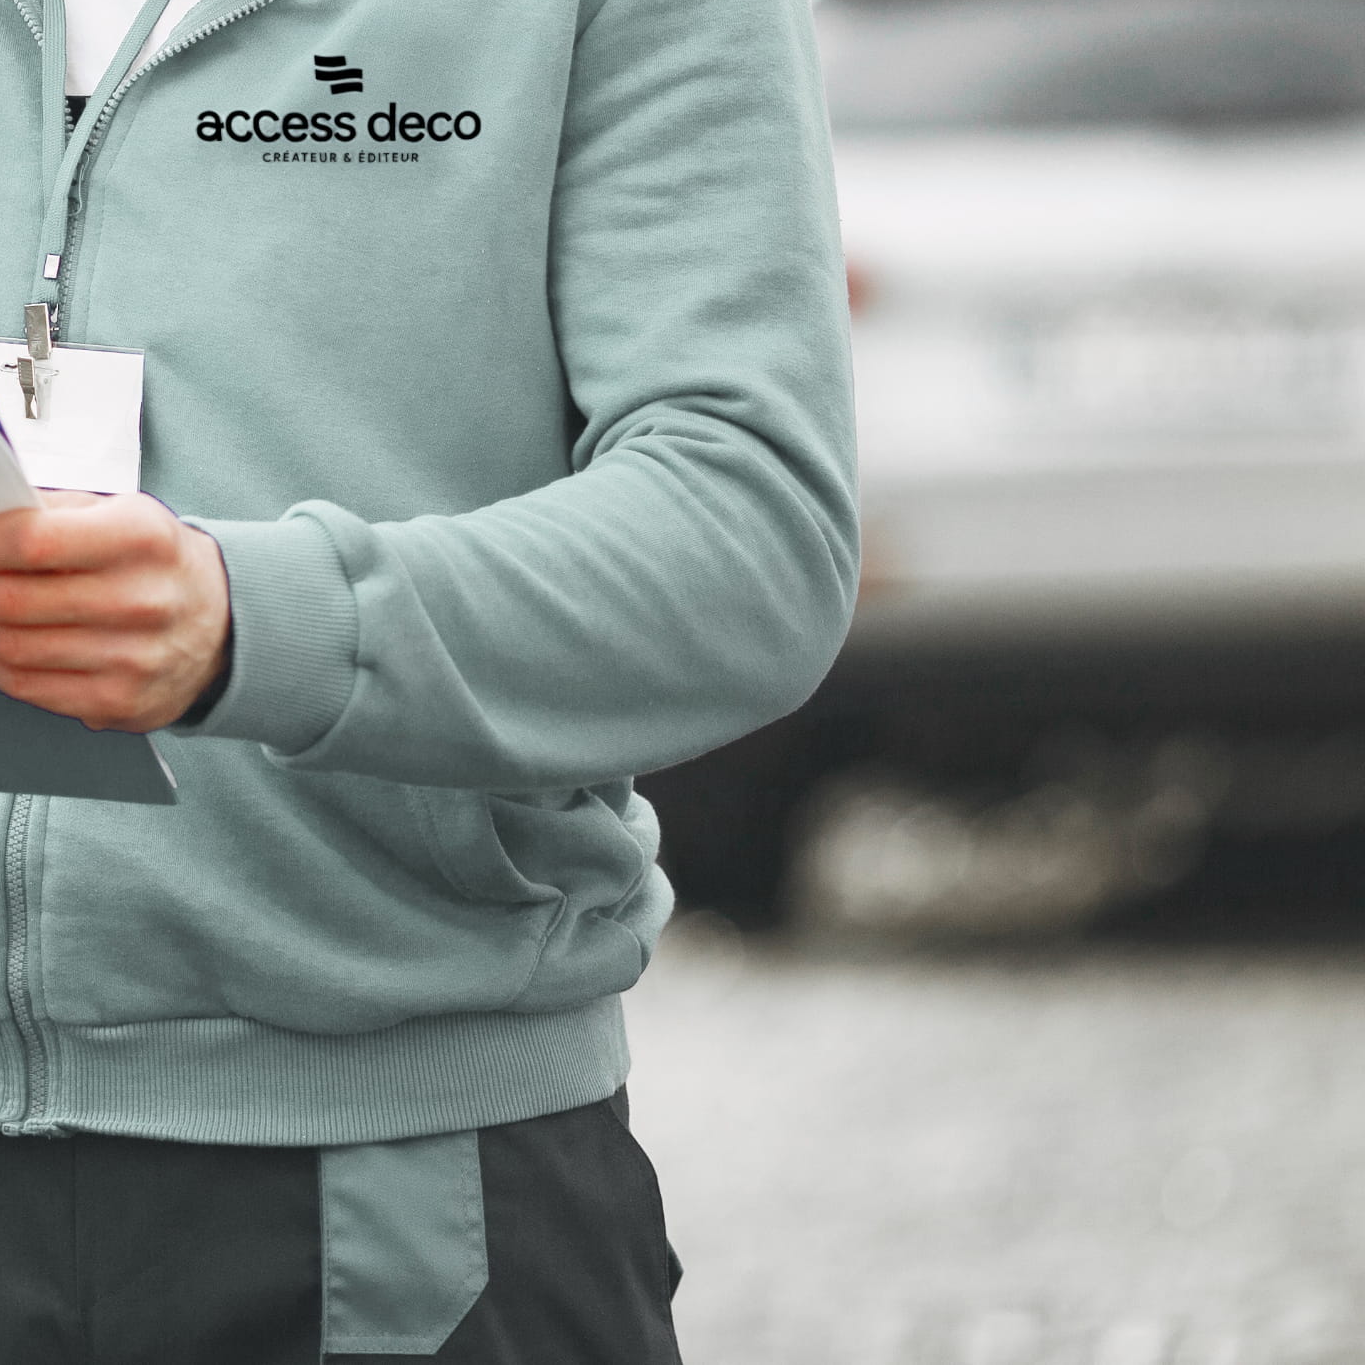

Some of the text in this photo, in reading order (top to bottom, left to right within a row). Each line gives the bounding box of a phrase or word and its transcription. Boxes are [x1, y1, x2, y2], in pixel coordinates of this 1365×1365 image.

[196, 102, 481, 143] access deco
[262, 149, 419, 163] CRÉATEUR & ÉDITEUR
